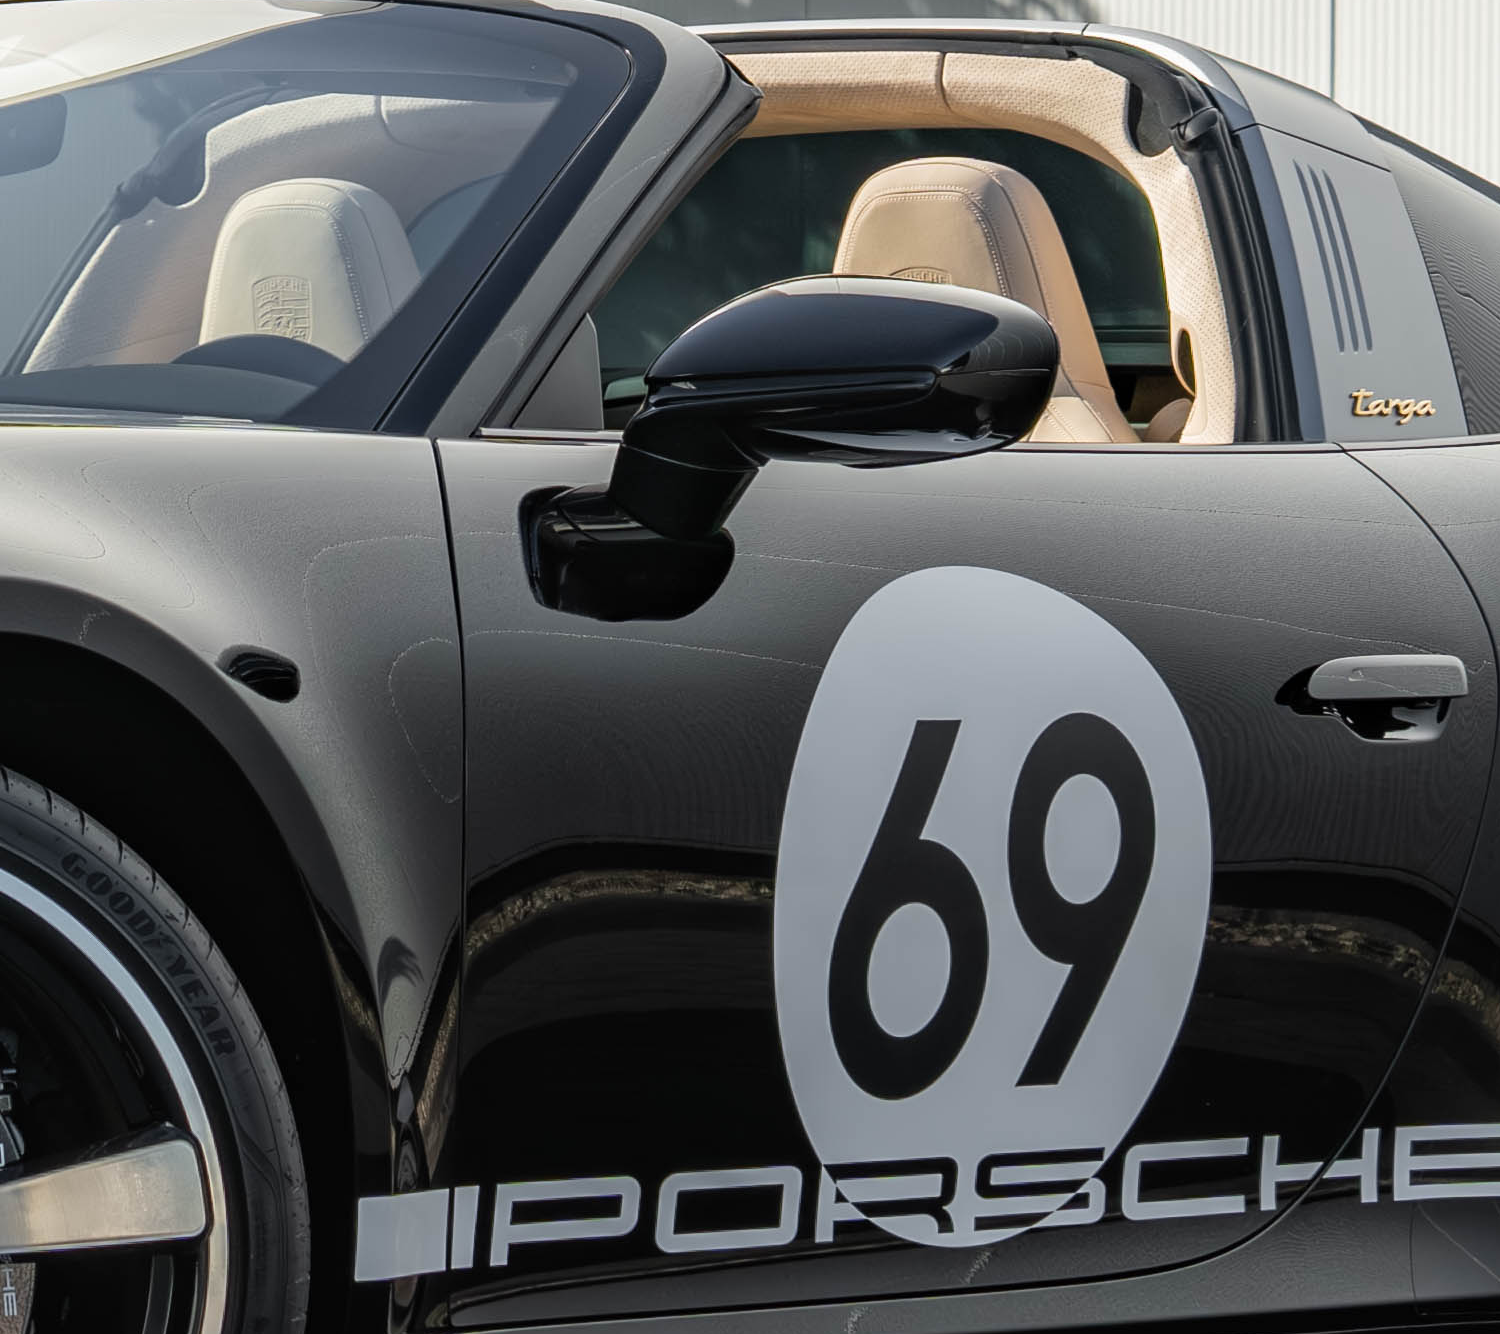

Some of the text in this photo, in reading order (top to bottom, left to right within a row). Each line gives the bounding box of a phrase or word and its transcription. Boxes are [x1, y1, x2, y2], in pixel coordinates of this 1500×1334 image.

[1351, 388, 1436, 424] targa
[60, 851, 236, 1057] GOODYEAR
[827, 711, 1156, 1101] 69
